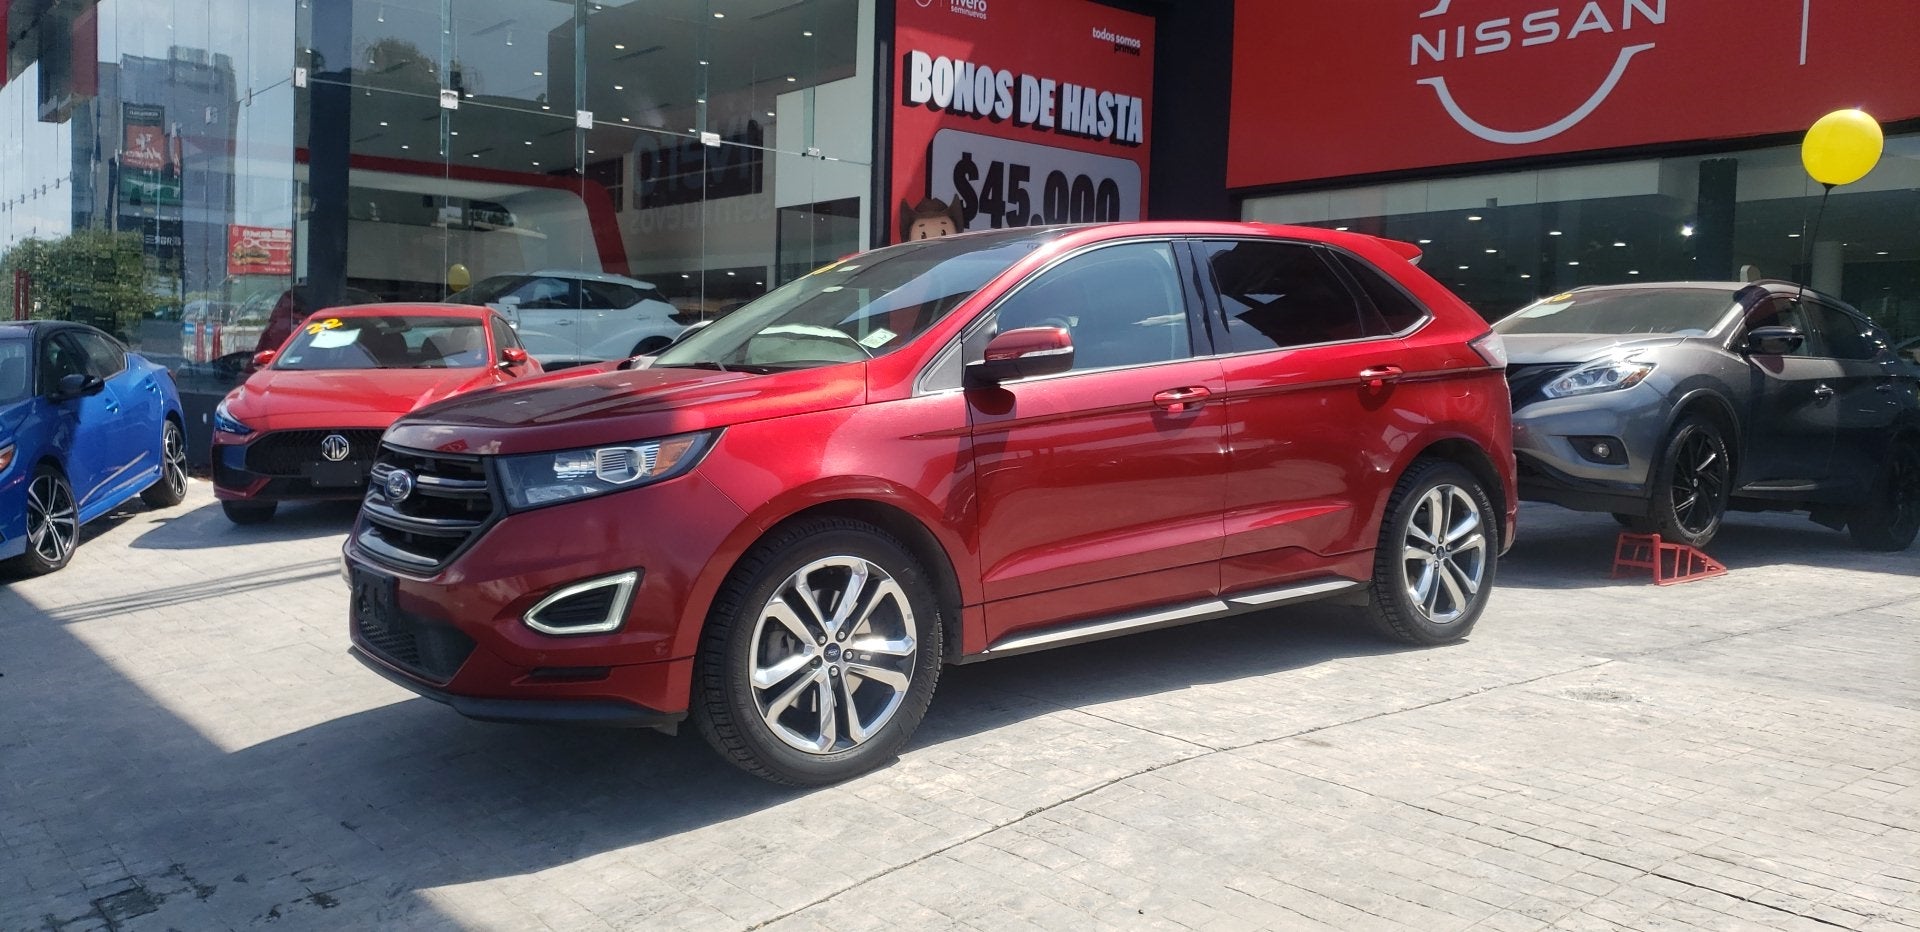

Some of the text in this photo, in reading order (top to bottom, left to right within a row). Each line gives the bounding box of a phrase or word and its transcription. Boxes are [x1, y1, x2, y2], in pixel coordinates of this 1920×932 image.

[951, 6, 987, 20] seminuevos
[1092, 26, 1141, 49] todos somos
[1410, 0, 1667, 66] NISSAN
[1114, 44, 1140, 56] primos
[909, 50, 1144, 144] BONOS DE HASTA
[305, 318, 344, 335] 22
[323, 437, 347, 459] MG
